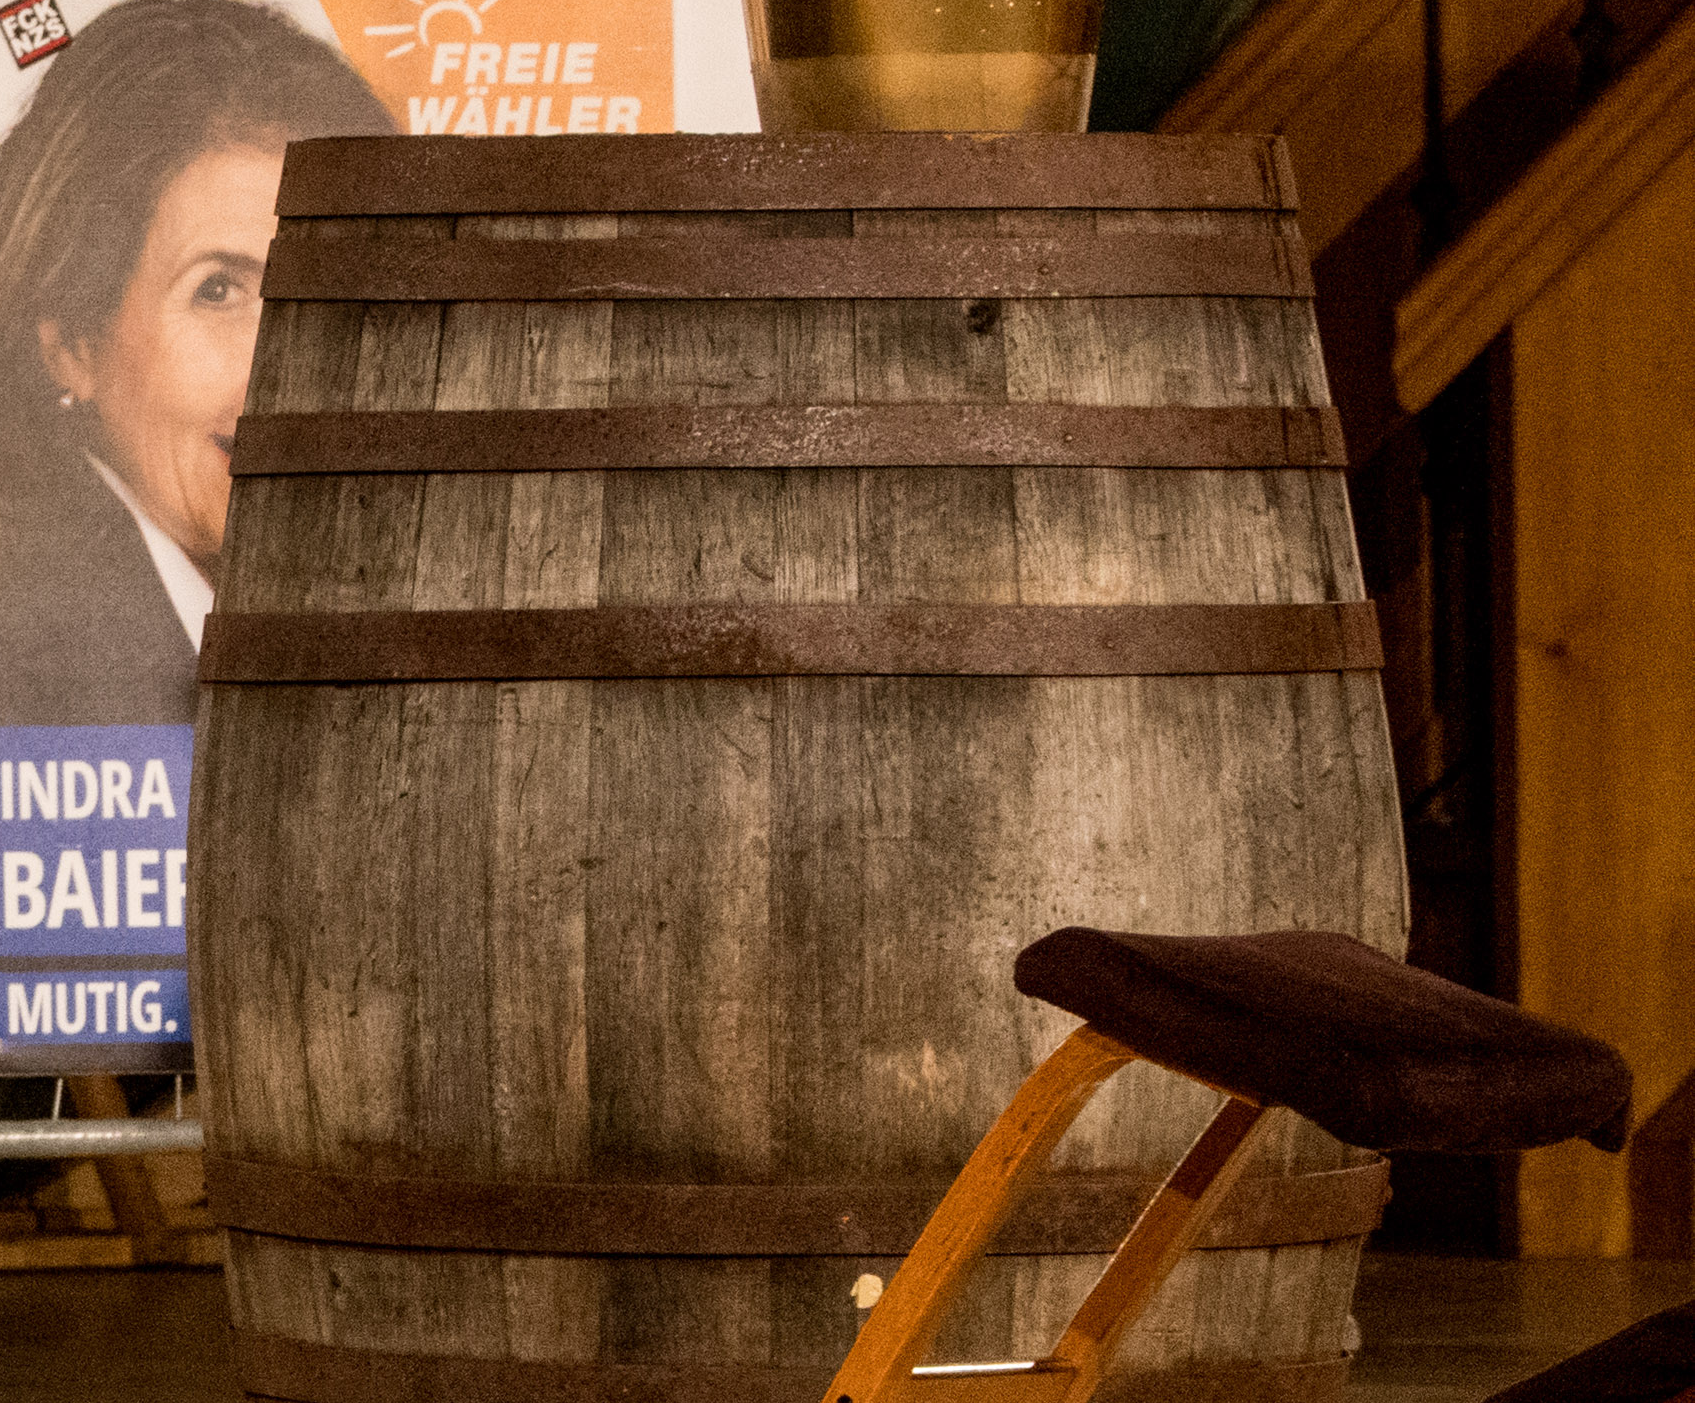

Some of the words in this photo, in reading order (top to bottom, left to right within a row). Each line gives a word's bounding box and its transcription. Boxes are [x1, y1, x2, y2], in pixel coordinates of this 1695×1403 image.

[10, 16, 67, 59] NZS
[430, 42, 600, 85] FREIE
[408, 87, 643, 136] WÄHLER
[0, 758, 177, 821] INDRA
[6, 980, 179, 1036] MUTIG.
